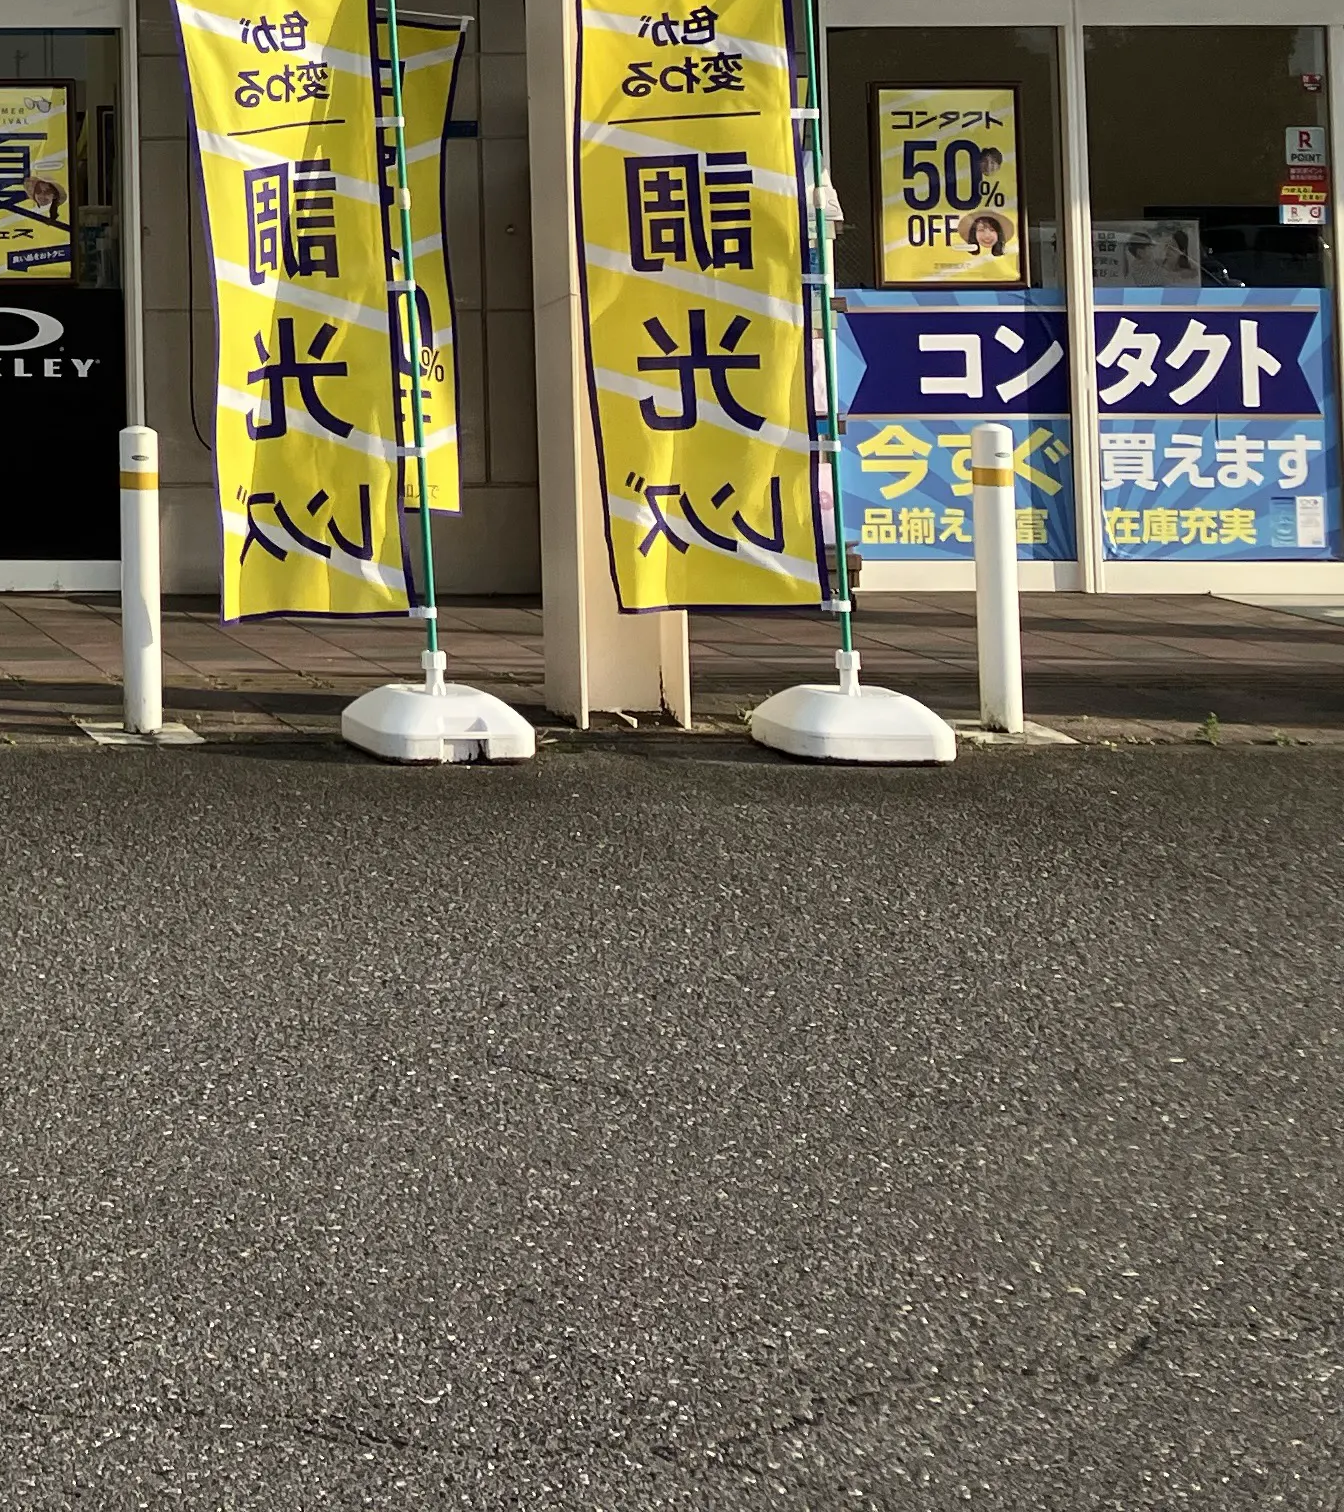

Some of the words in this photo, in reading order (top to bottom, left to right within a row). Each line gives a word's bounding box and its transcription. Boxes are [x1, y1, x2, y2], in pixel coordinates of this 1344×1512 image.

[890, 110, 1004, 130] コンタクト
[903, 139, 1005, 211] 50%
[1291, 153, 1322, 162] POINT
[907, 214, 960, 247] OFF
[917, 317, 1283, 408] コンタクト
[860, 507, 1049, 545] 品揃え富
[1105, 507, 1258, 546] 在庫充実
